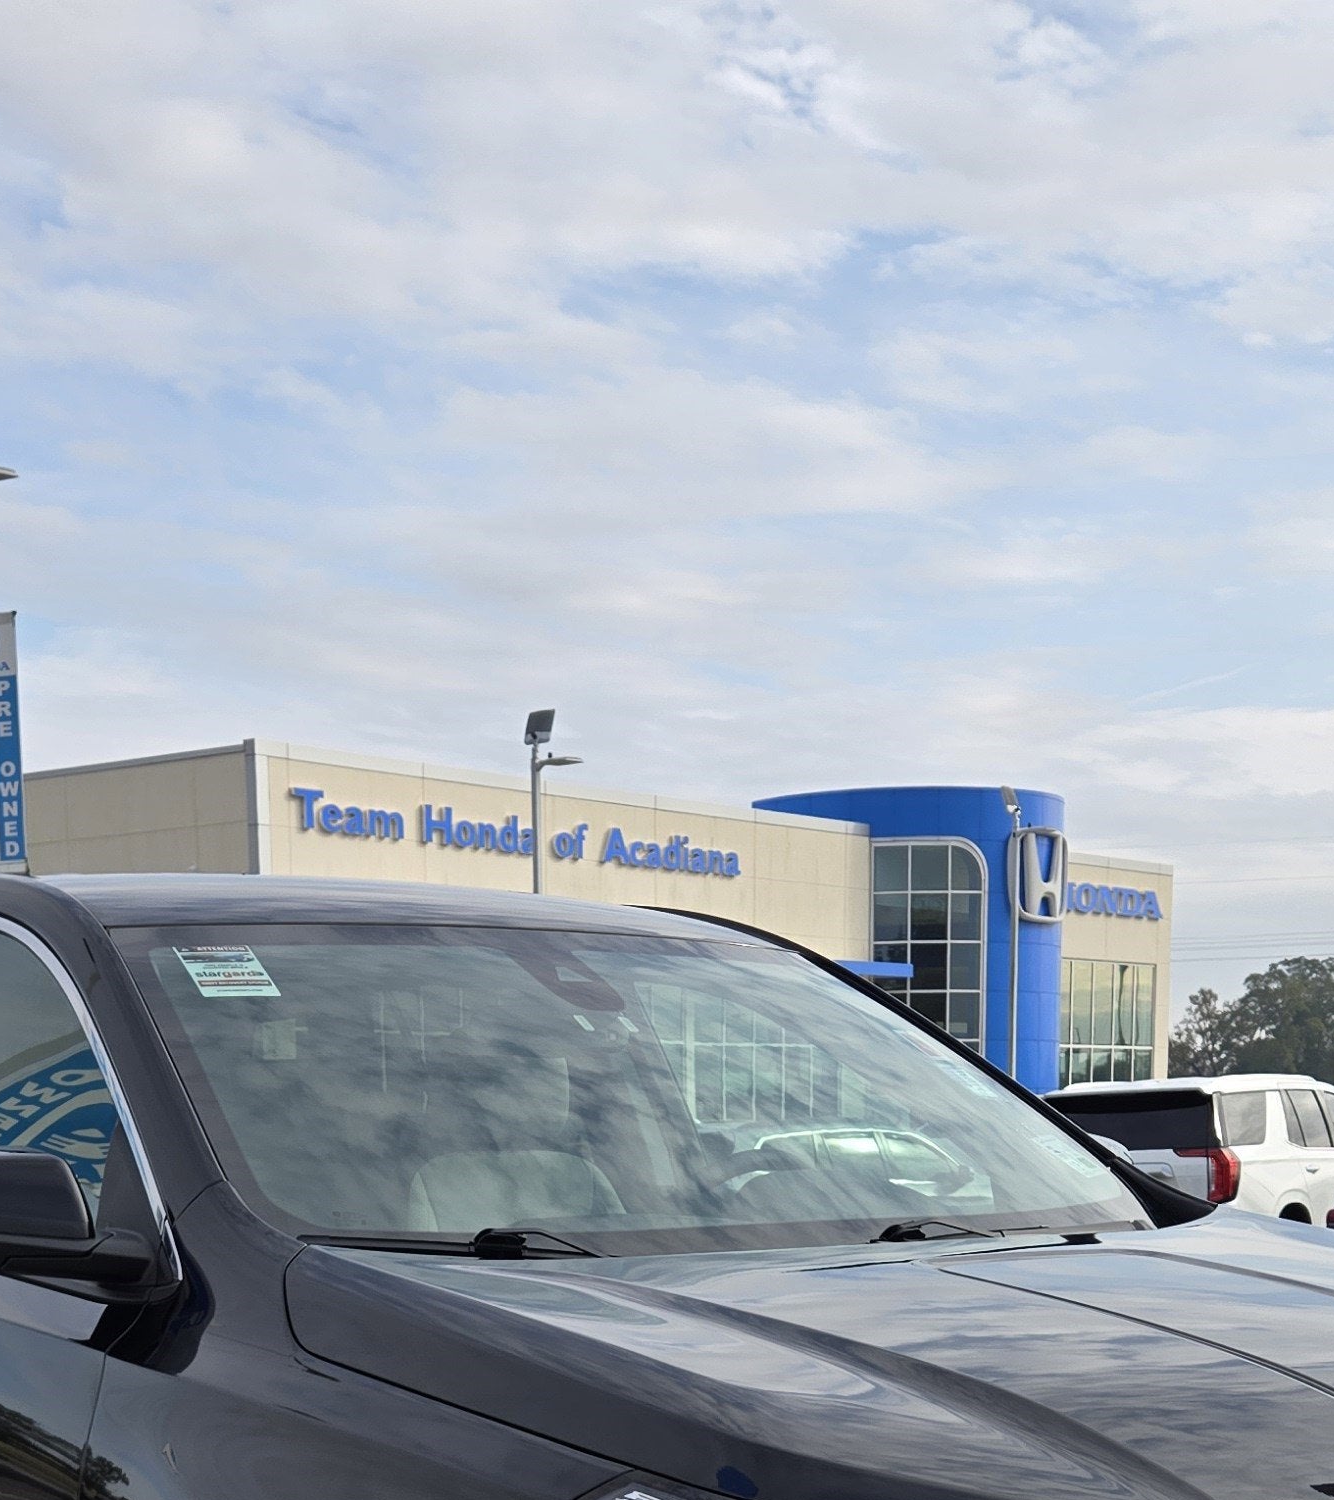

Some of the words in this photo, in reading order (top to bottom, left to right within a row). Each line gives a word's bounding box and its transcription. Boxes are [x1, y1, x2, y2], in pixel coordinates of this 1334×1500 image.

[0, 760, 20, 857] OWNED
[289, 787, 405, 840] Team
[421, 804, 534, 855] Honda
[553, 822, 589, 859] of
[603, 827, 742, 877] Acadiana
